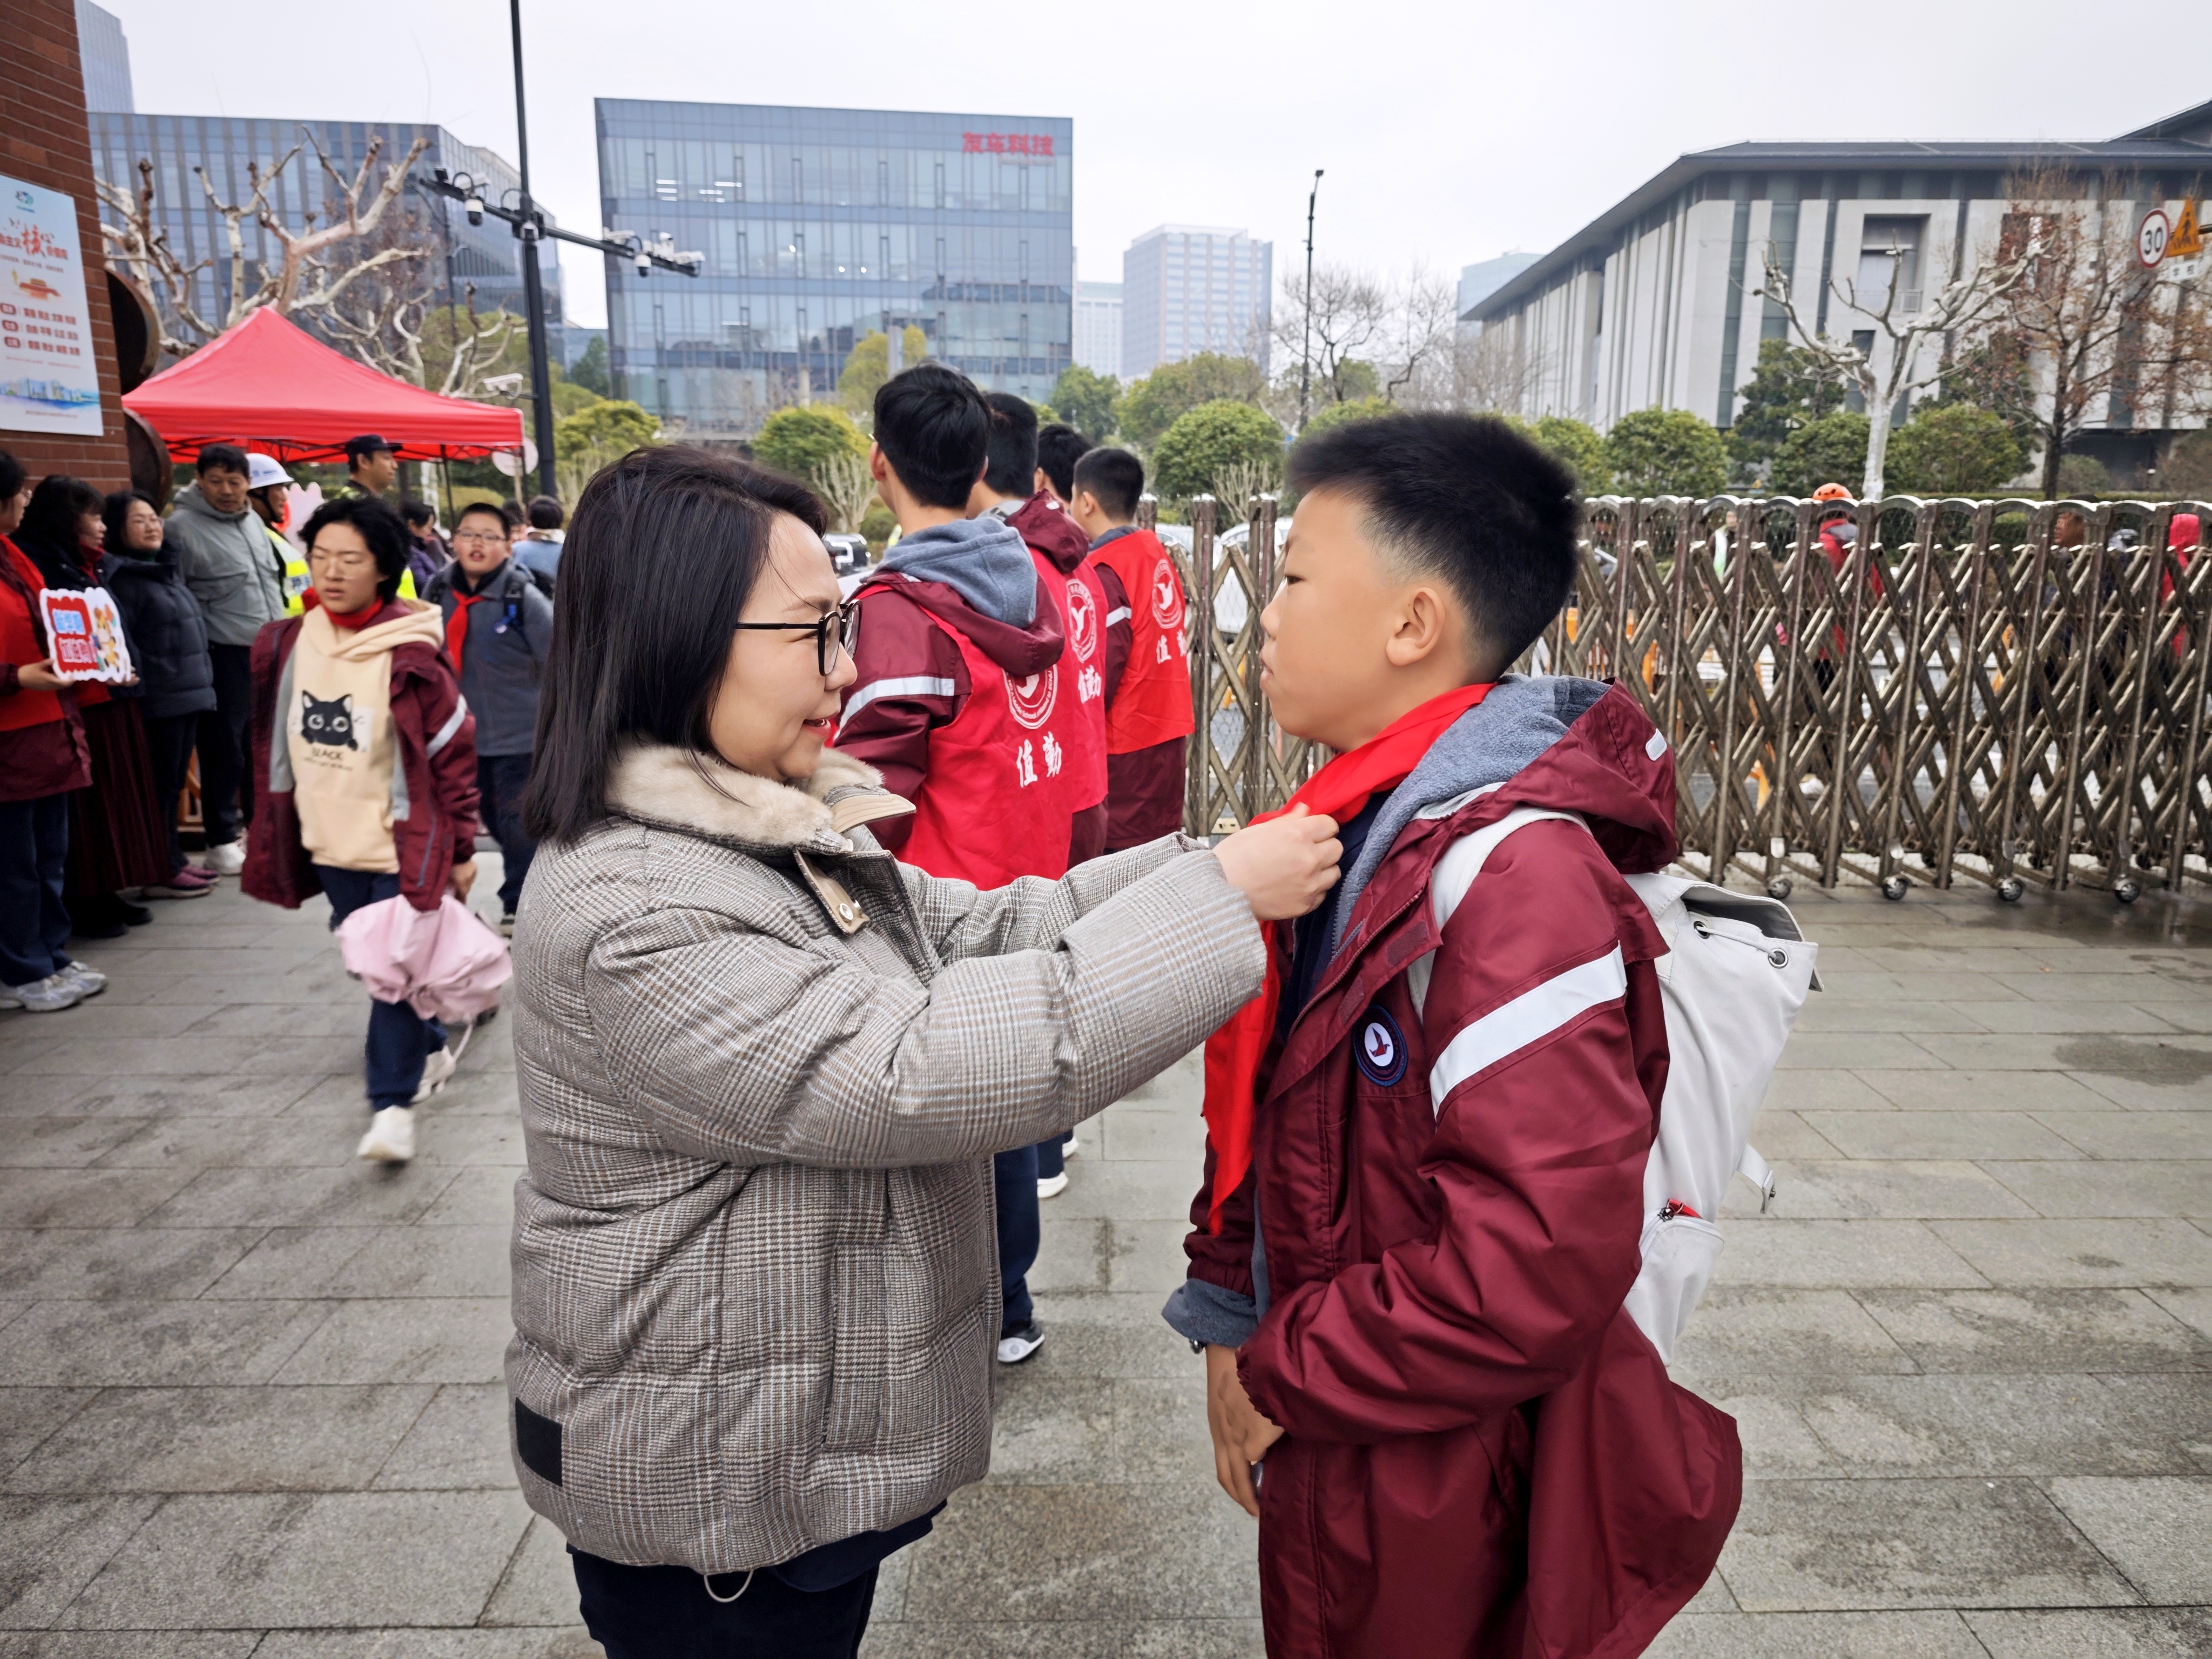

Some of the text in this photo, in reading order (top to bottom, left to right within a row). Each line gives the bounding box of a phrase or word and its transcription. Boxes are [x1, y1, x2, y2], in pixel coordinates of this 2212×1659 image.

[962, 132, 1053, 156] 友车科技
[2144, 227, 2163, 255] 30
[2173, 265, 2194, 276] 学校
[1156, 629, 1188, 664] 值勤
[1077, 665, 1102, 704] 值勤
[1016, 731, 1062, 788] 值勤
